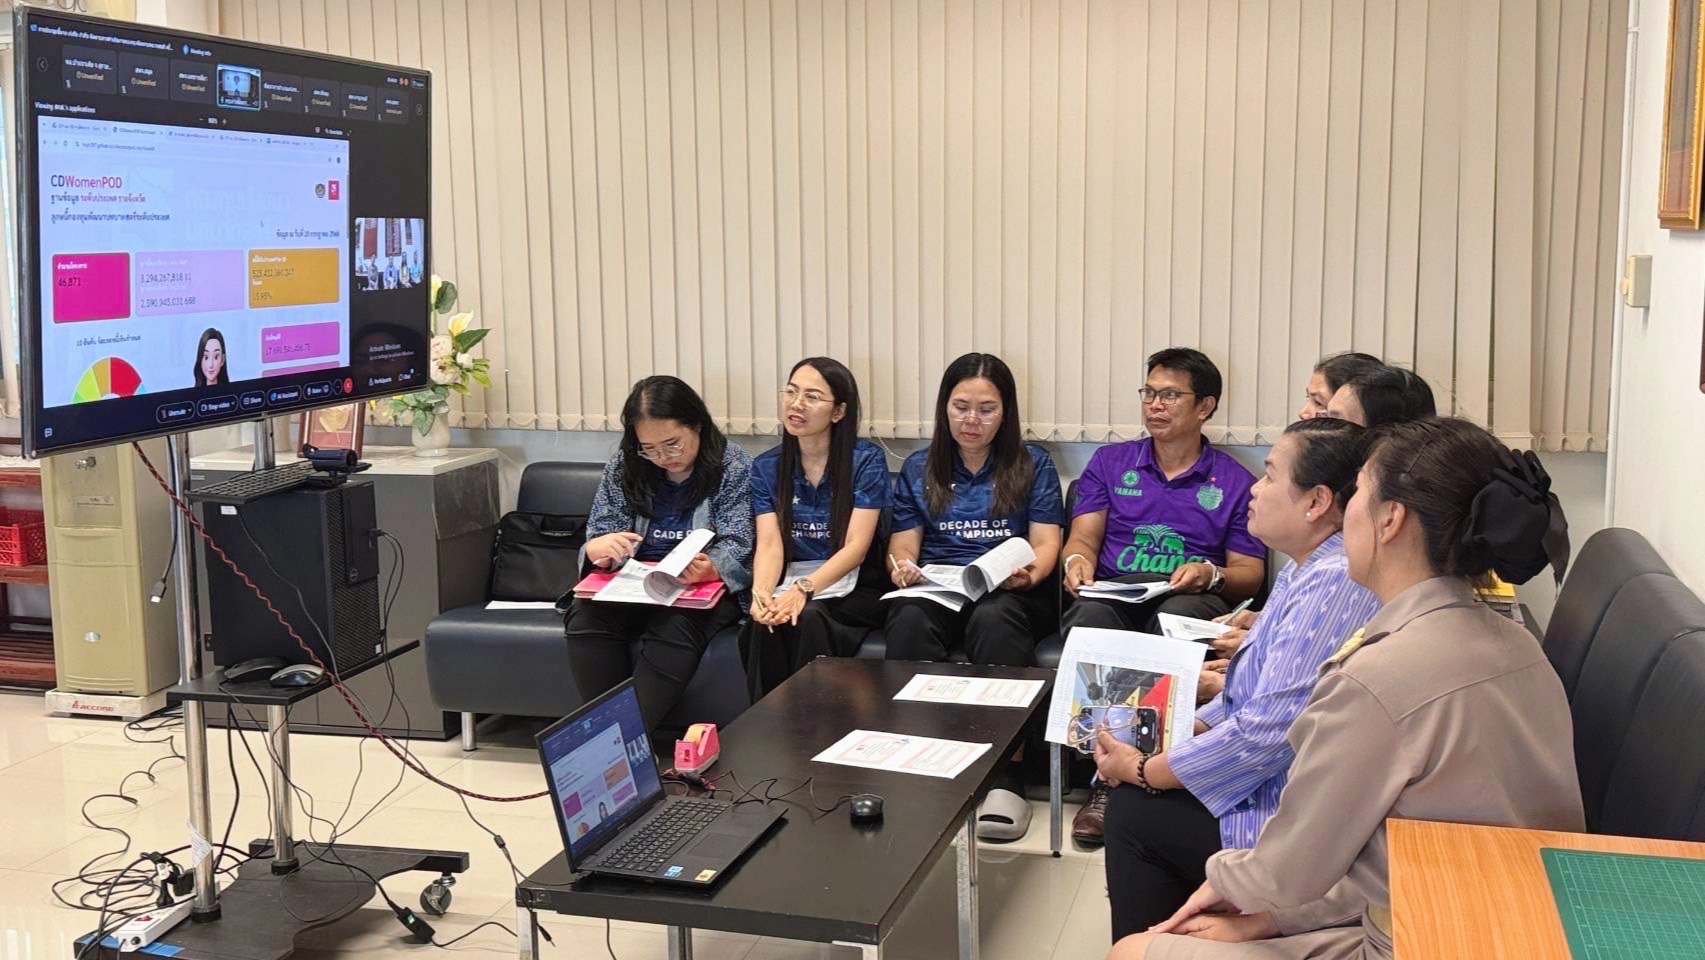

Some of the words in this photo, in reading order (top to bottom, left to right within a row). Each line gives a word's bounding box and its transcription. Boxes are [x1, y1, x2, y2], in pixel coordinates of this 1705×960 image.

[50, 174, 123, 189] CDWomenPOD
[1114, 487, 1143, 496] YAMAHA
[939, 520, 988, 531] DECADE
[992, 519, 1008, 528] OF
